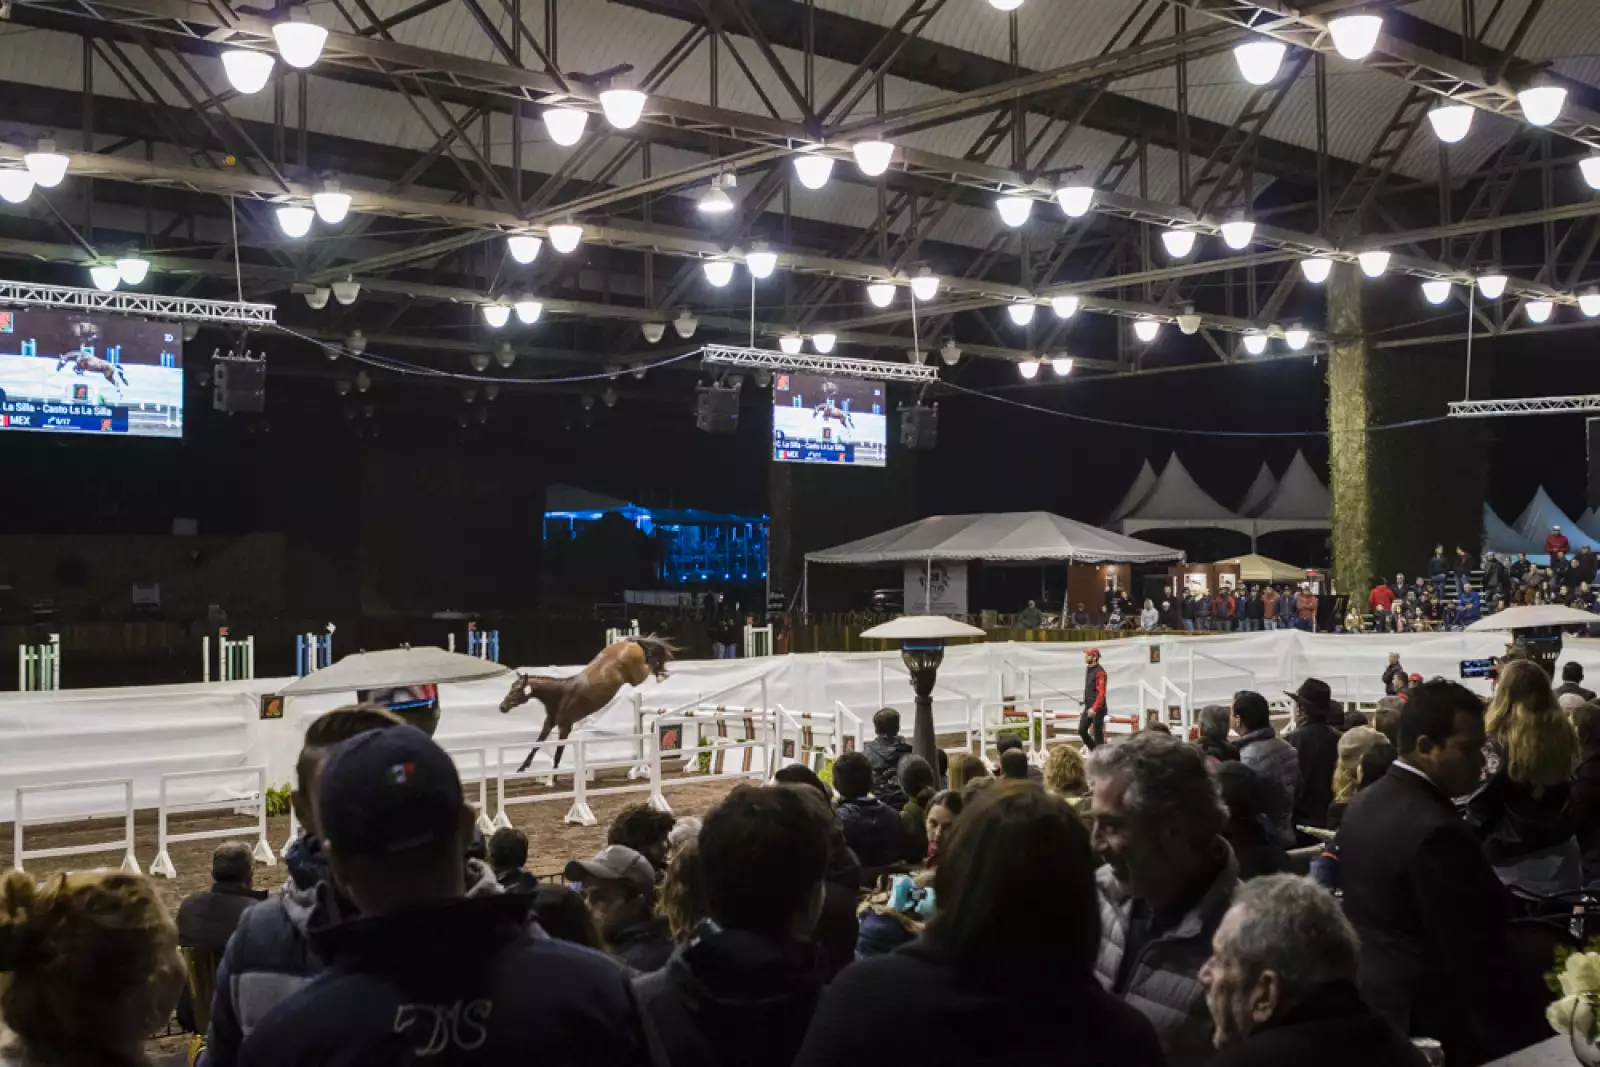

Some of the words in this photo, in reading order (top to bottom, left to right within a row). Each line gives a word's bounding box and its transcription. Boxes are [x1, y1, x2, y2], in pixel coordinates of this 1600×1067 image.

[3, 401, 14, 411] La
[16, 402, 35, 412] Silla
[82, 406, 92, 415] La
[94, 406, 113, 417] Silla
[10, 416, 31, 425] MEX
